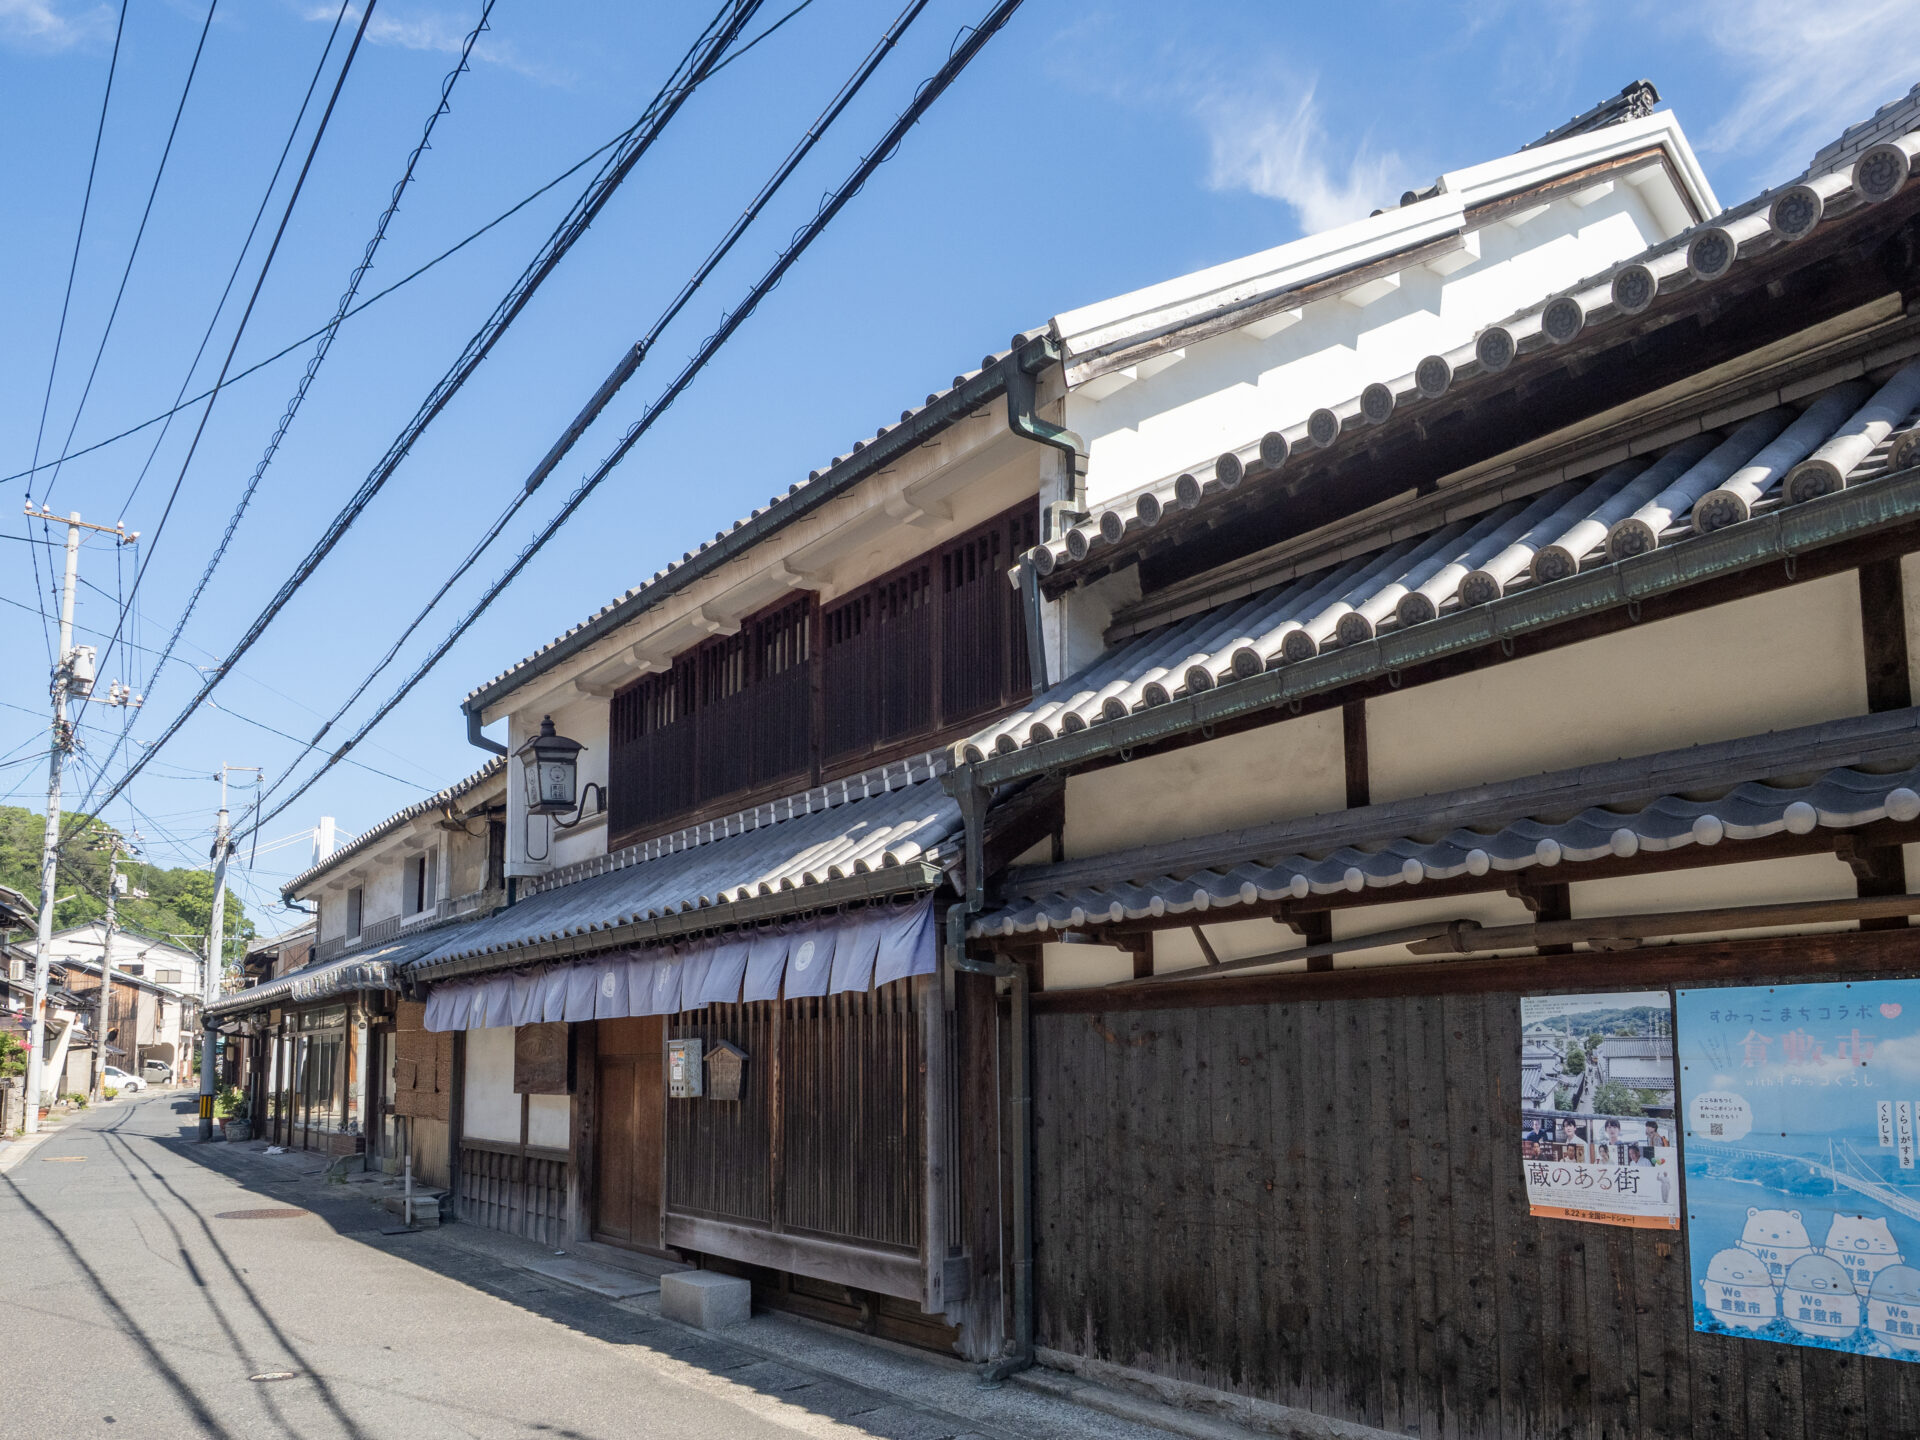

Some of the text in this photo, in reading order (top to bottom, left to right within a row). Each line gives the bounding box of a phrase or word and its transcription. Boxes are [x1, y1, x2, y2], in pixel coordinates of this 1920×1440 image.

[1709, 1004, 1873, 1024] すみっこまちコラボ
[1736, 1027, 1878, 1068] 倉敷市
[1881, 1103, 1890, 1145] くらしき
[1900, 1103, 1912, 1166] くらしがすき
[1527, 1162, 1641, 1194] 蔵のある街
[1564, 1208, 1580, 1218] 8.22
[1757, 1248, 1778, 1261] We
[1842, 1254, 1866, 1267] We
[1721, 1286, 1742, 1298] We
[1720, 1298, 1761, 1314] 倉敷市
[1800, 1294, 1822, 1307] We
[1798, 1307, 1842, 1324] 倉敷市
[1886, 1305, 1909, 1319] We
